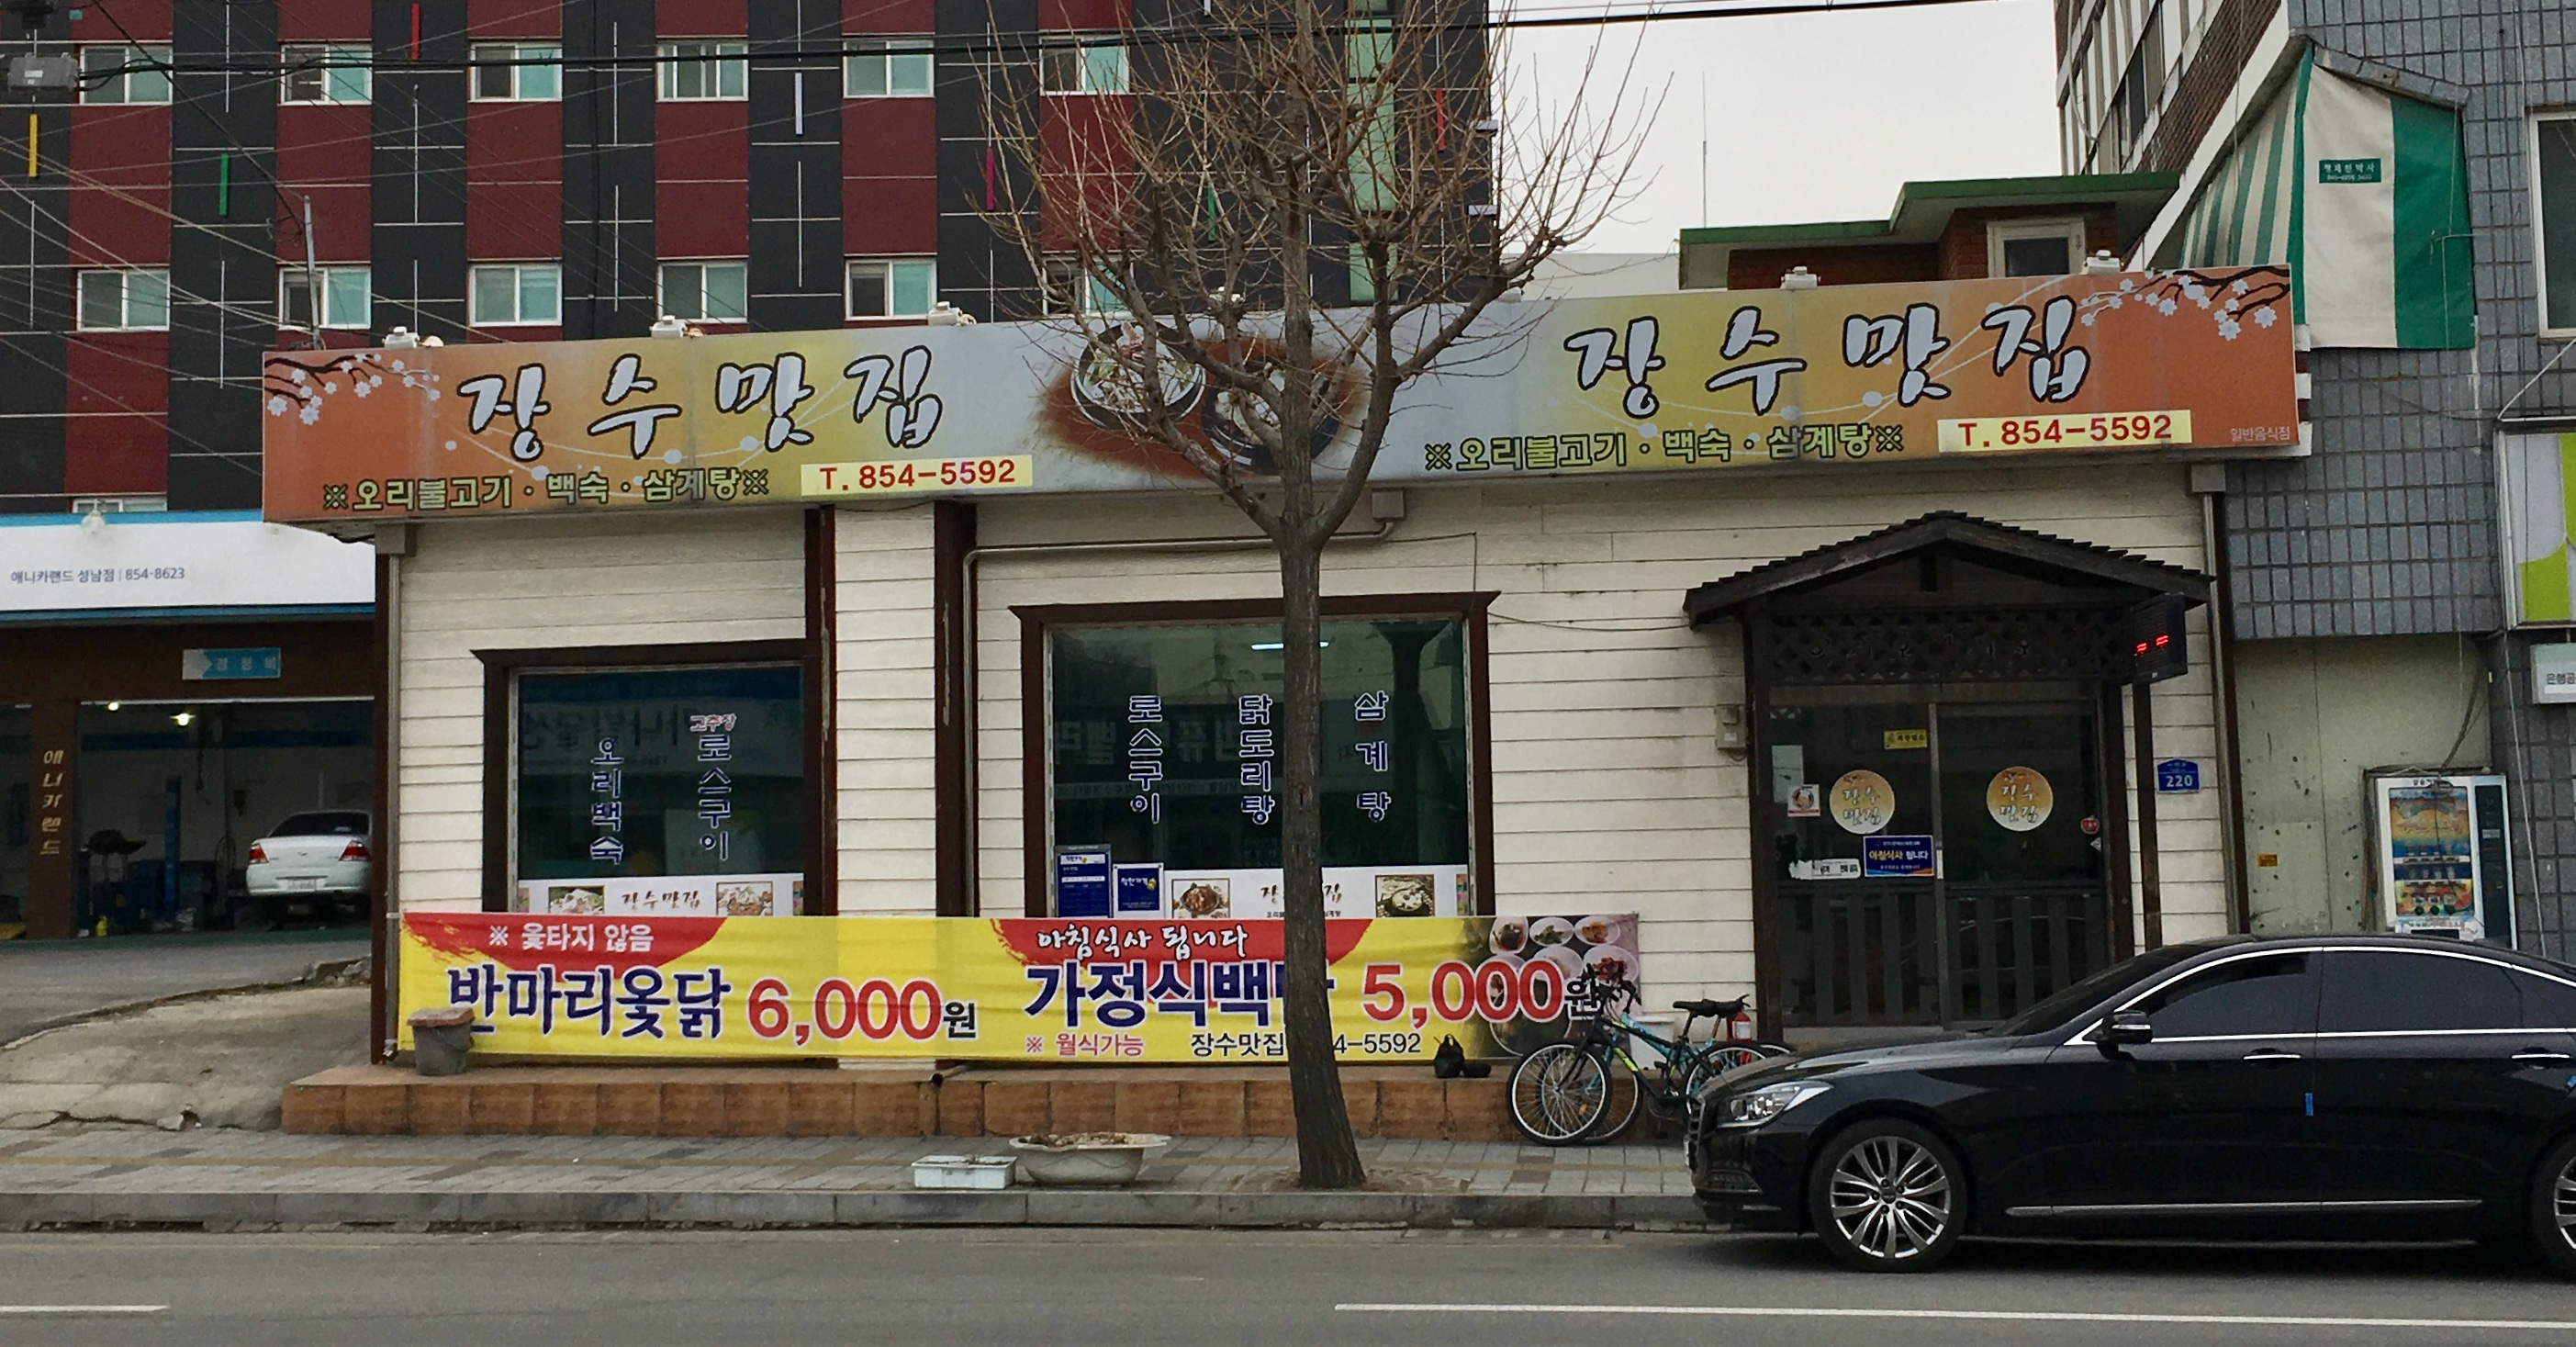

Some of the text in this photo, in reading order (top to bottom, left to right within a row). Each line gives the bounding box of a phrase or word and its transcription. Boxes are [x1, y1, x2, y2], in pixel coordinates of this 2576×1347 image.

[1663, 427, 1732, 464] 백숙
[2230, 425, 2290, 443] 일반음식점
[546, 471, 610, 505] 백숙
[11, 567, 185, 584] 애니카랜드 성남점 854-8623
[689, 713, 736, 732] 고추장
[1127, 694, 1164, 825] 로스구이
[1238, 693, 1275, 825] 닭도리탕
[1354, 690, 1392, 822] 삼계탕
[698, 735, 732, 861] 로스구이
[2166, 775, 2193, 787] 220
[589, 737, 624, 864] 오리백숙
[521, 922, 594, 950] 옻타지
[604, 924, 654, 951] 않음
[1037, 924, 1248, 960] 아침식사 됩니다
[447, 963, 732, 1039] 반마리옻닭
[1024, 960, 1335, 1027] 가정식백
[1056, 1033, 1144, 1057] 월식가능
[1191, 1033, 1285, 1057] 장수맛집
